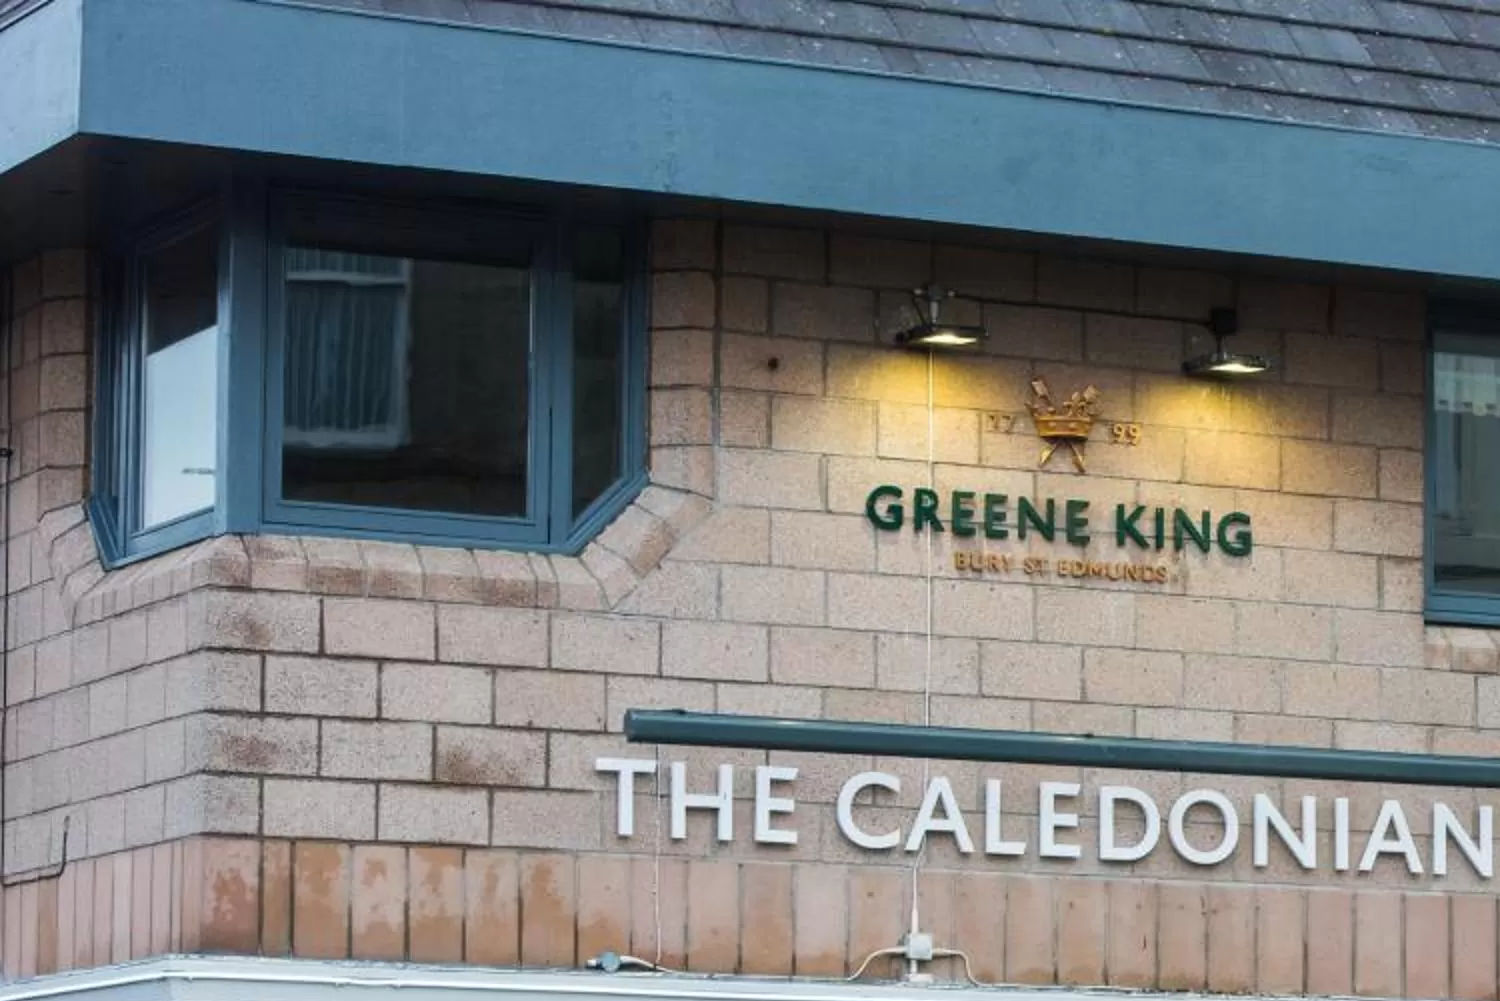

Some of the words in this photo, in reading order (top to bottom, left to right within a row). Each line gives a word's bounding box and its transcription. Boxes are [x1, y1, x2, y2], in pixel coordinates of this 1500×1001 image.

[1112, 422, 1144, 447] 99
[866, 485, 1091, 547] GREENE
[1116, 503, 1253, 557] KING
[954, 550, 1010, 574] BURY
[1023, 554, 1048, 577] ST
[1057, 557, 1169, 585] EDMUNDS
[595, 757, 799, 846] THE
[836, 771, 1494, 879] CALEDONIAN
